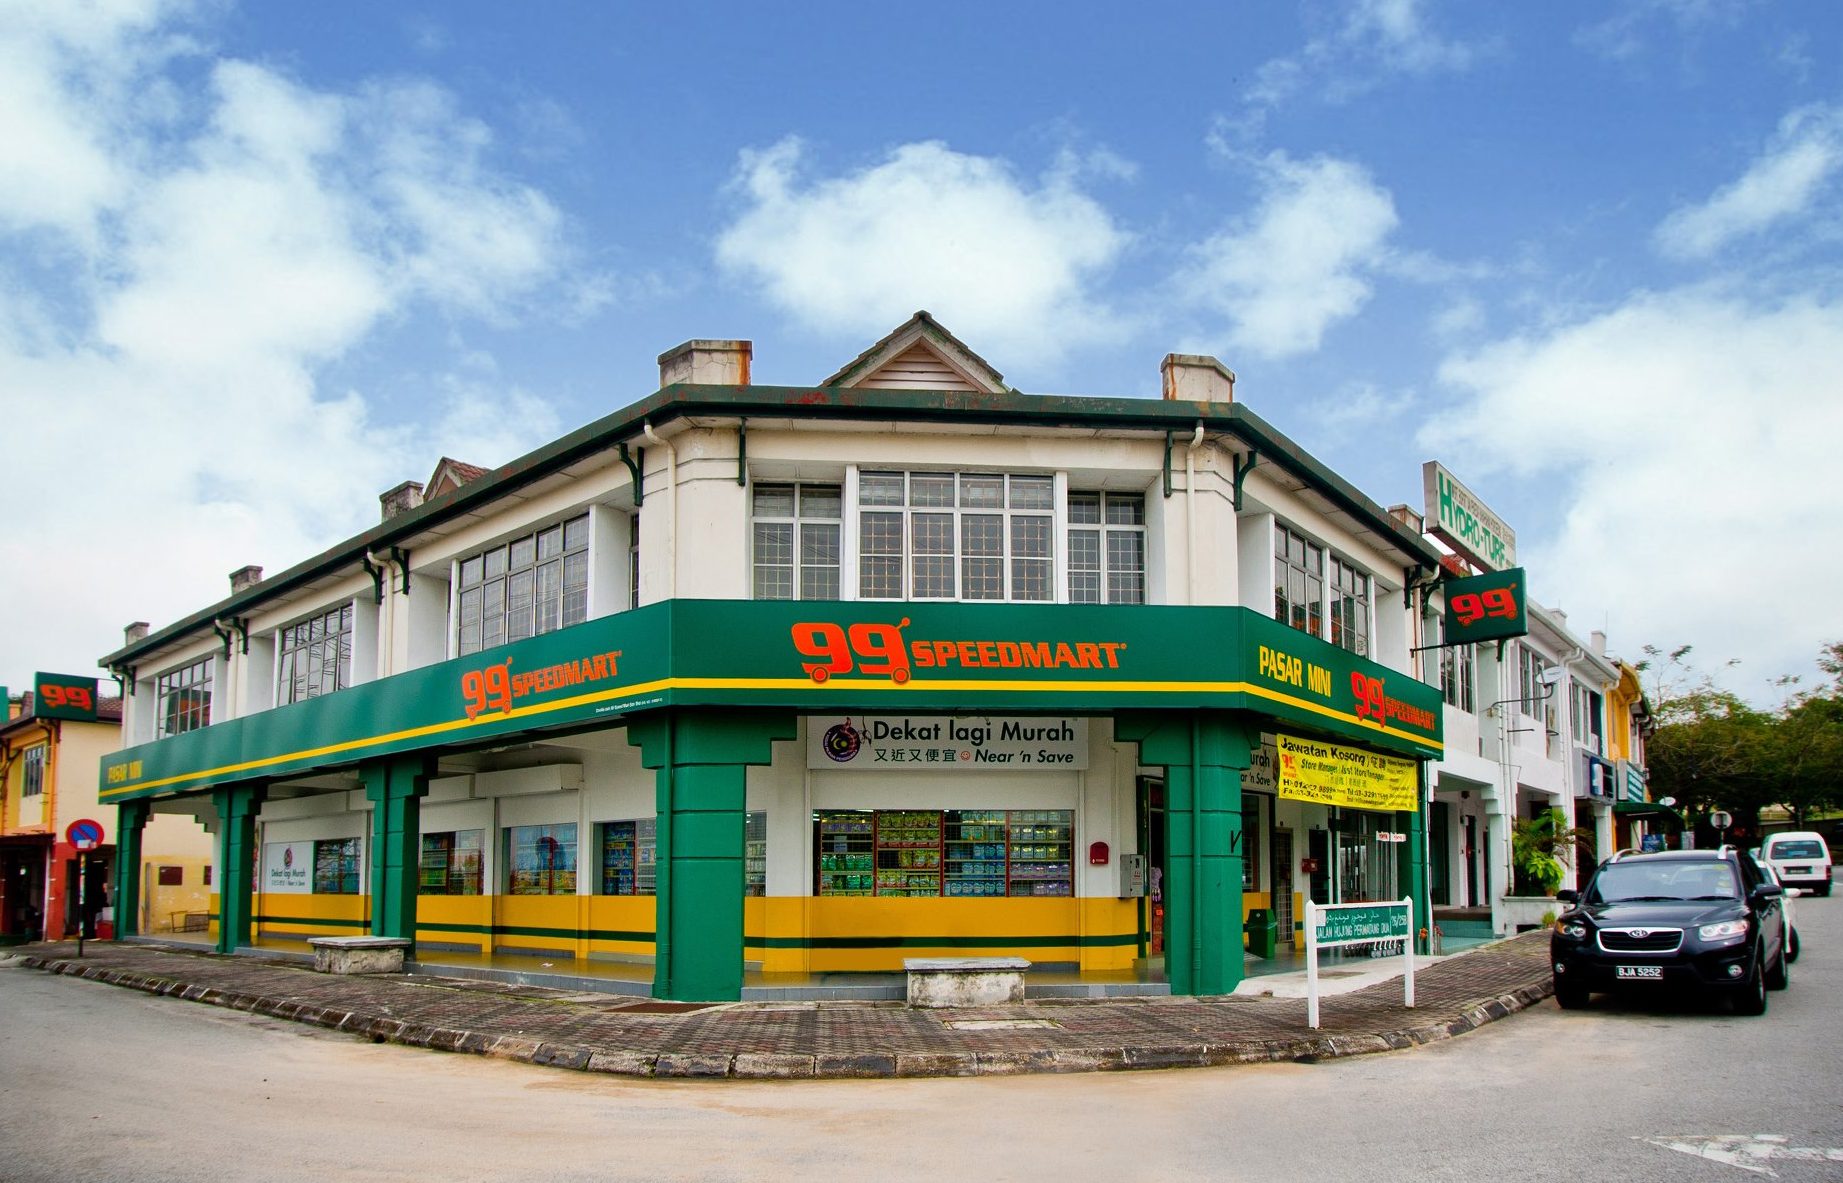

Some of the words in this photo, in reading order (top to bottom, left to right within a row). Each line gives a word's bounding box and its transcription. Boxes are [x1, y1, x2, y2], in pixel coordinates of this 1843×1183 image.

[1451, 583, 1518, 627] 99
[791, 617, 911, 684] 99
[911, 641, 1121, 669] SPEEDMART
[1259, 645, 1303, 688] PASAR
[1308, 663, 1332, 698] MINI
[39, 684, 93, 711] 99
[461, 656, 513, 721] 99
[511, 651, 619, 698] SPEEDMART
[1351, 671, 1386, 728] 99
[873, 719, 941, 741] Dekat
[949, 719, 992, 747] lagi
[1000, 720, 1075, 742] Murah
[873, 748, 957, 763] 又近又便宜
[974, 749, 1014, 764] Near
[1037, 749, 1074, 764] Save
[1250, 749, 1270, 768] urah
[1281, 738, 1328, 759] Jawatan
[1330, 747, 1366, 767] Kosong
[1316, 926, 1333, 939] JALAN
[1618, 967, 1636, 977] BJA
[1637, 967, 1662, 977] 5252
